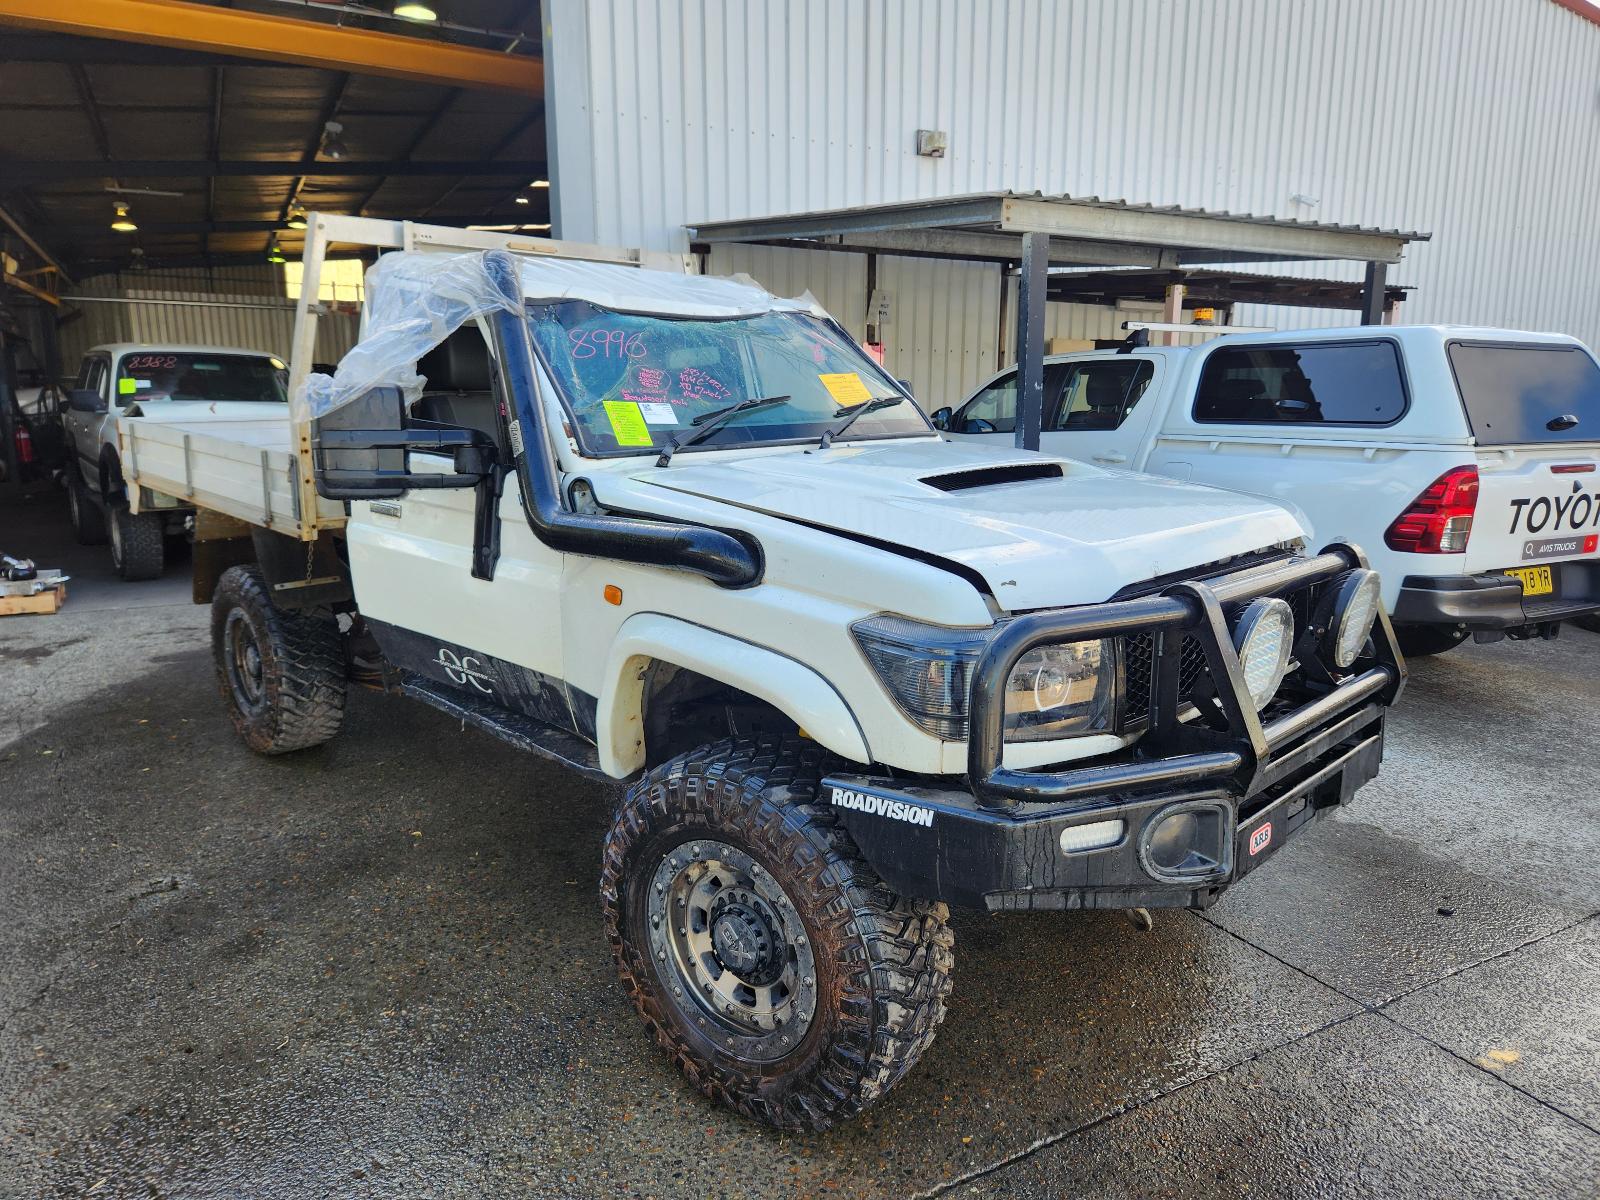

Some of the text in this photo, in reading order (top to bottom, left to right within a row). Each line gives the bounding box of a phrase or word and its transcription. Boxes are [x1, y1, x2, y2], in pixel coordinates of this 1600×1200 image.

[569, 329, 647, 359] 8996
[1539, 542, 1577, 553] AVIS TRUCKS
